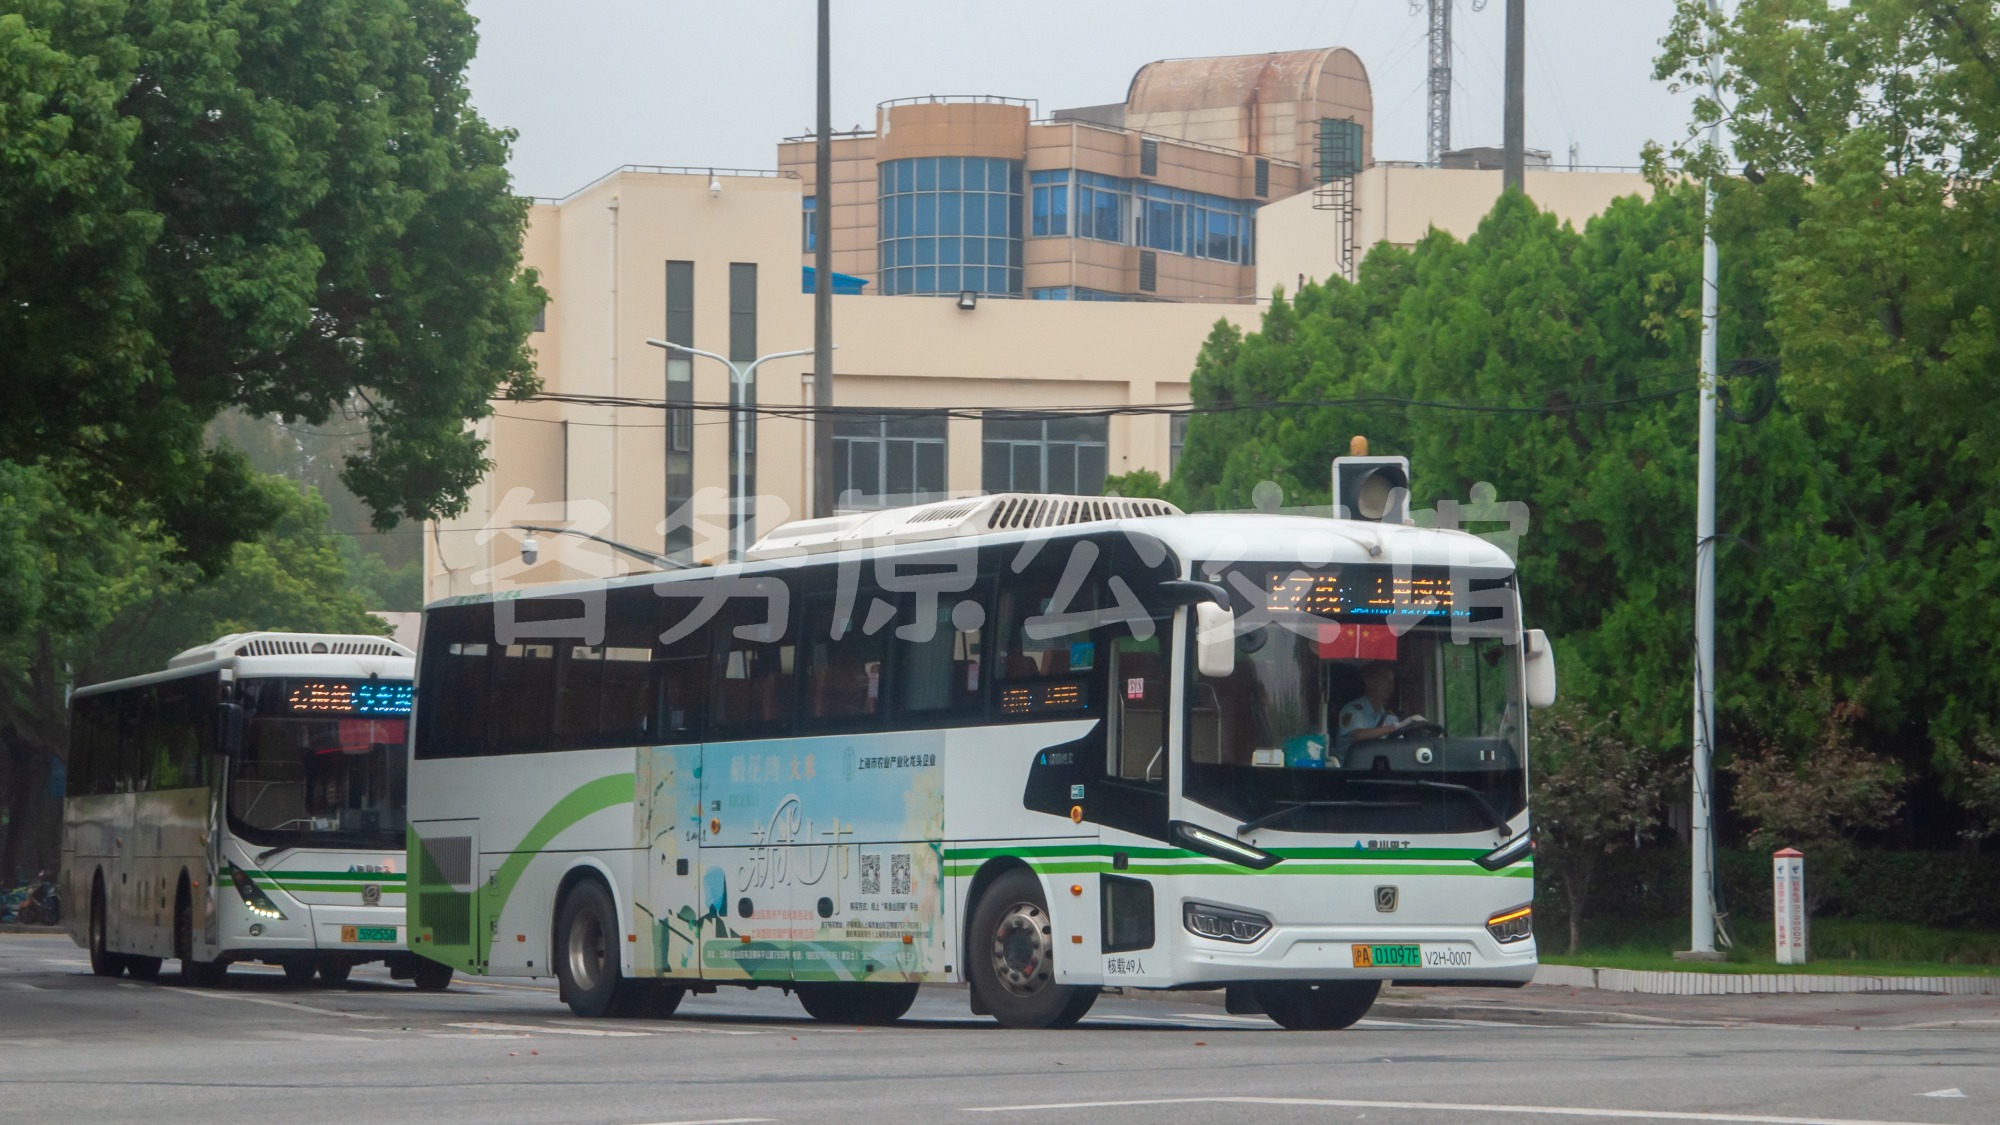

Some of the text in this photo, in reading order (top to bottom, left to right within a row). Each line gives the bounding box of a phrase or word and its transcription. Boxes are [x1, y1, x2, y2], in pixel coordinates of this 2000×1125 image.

[858, 754, 936, 769] 上海市农业产业化龙头企业
[1107, 957, 1146, 975] 核载49人
[1425, 952, 1472, 966] V2H-0007
